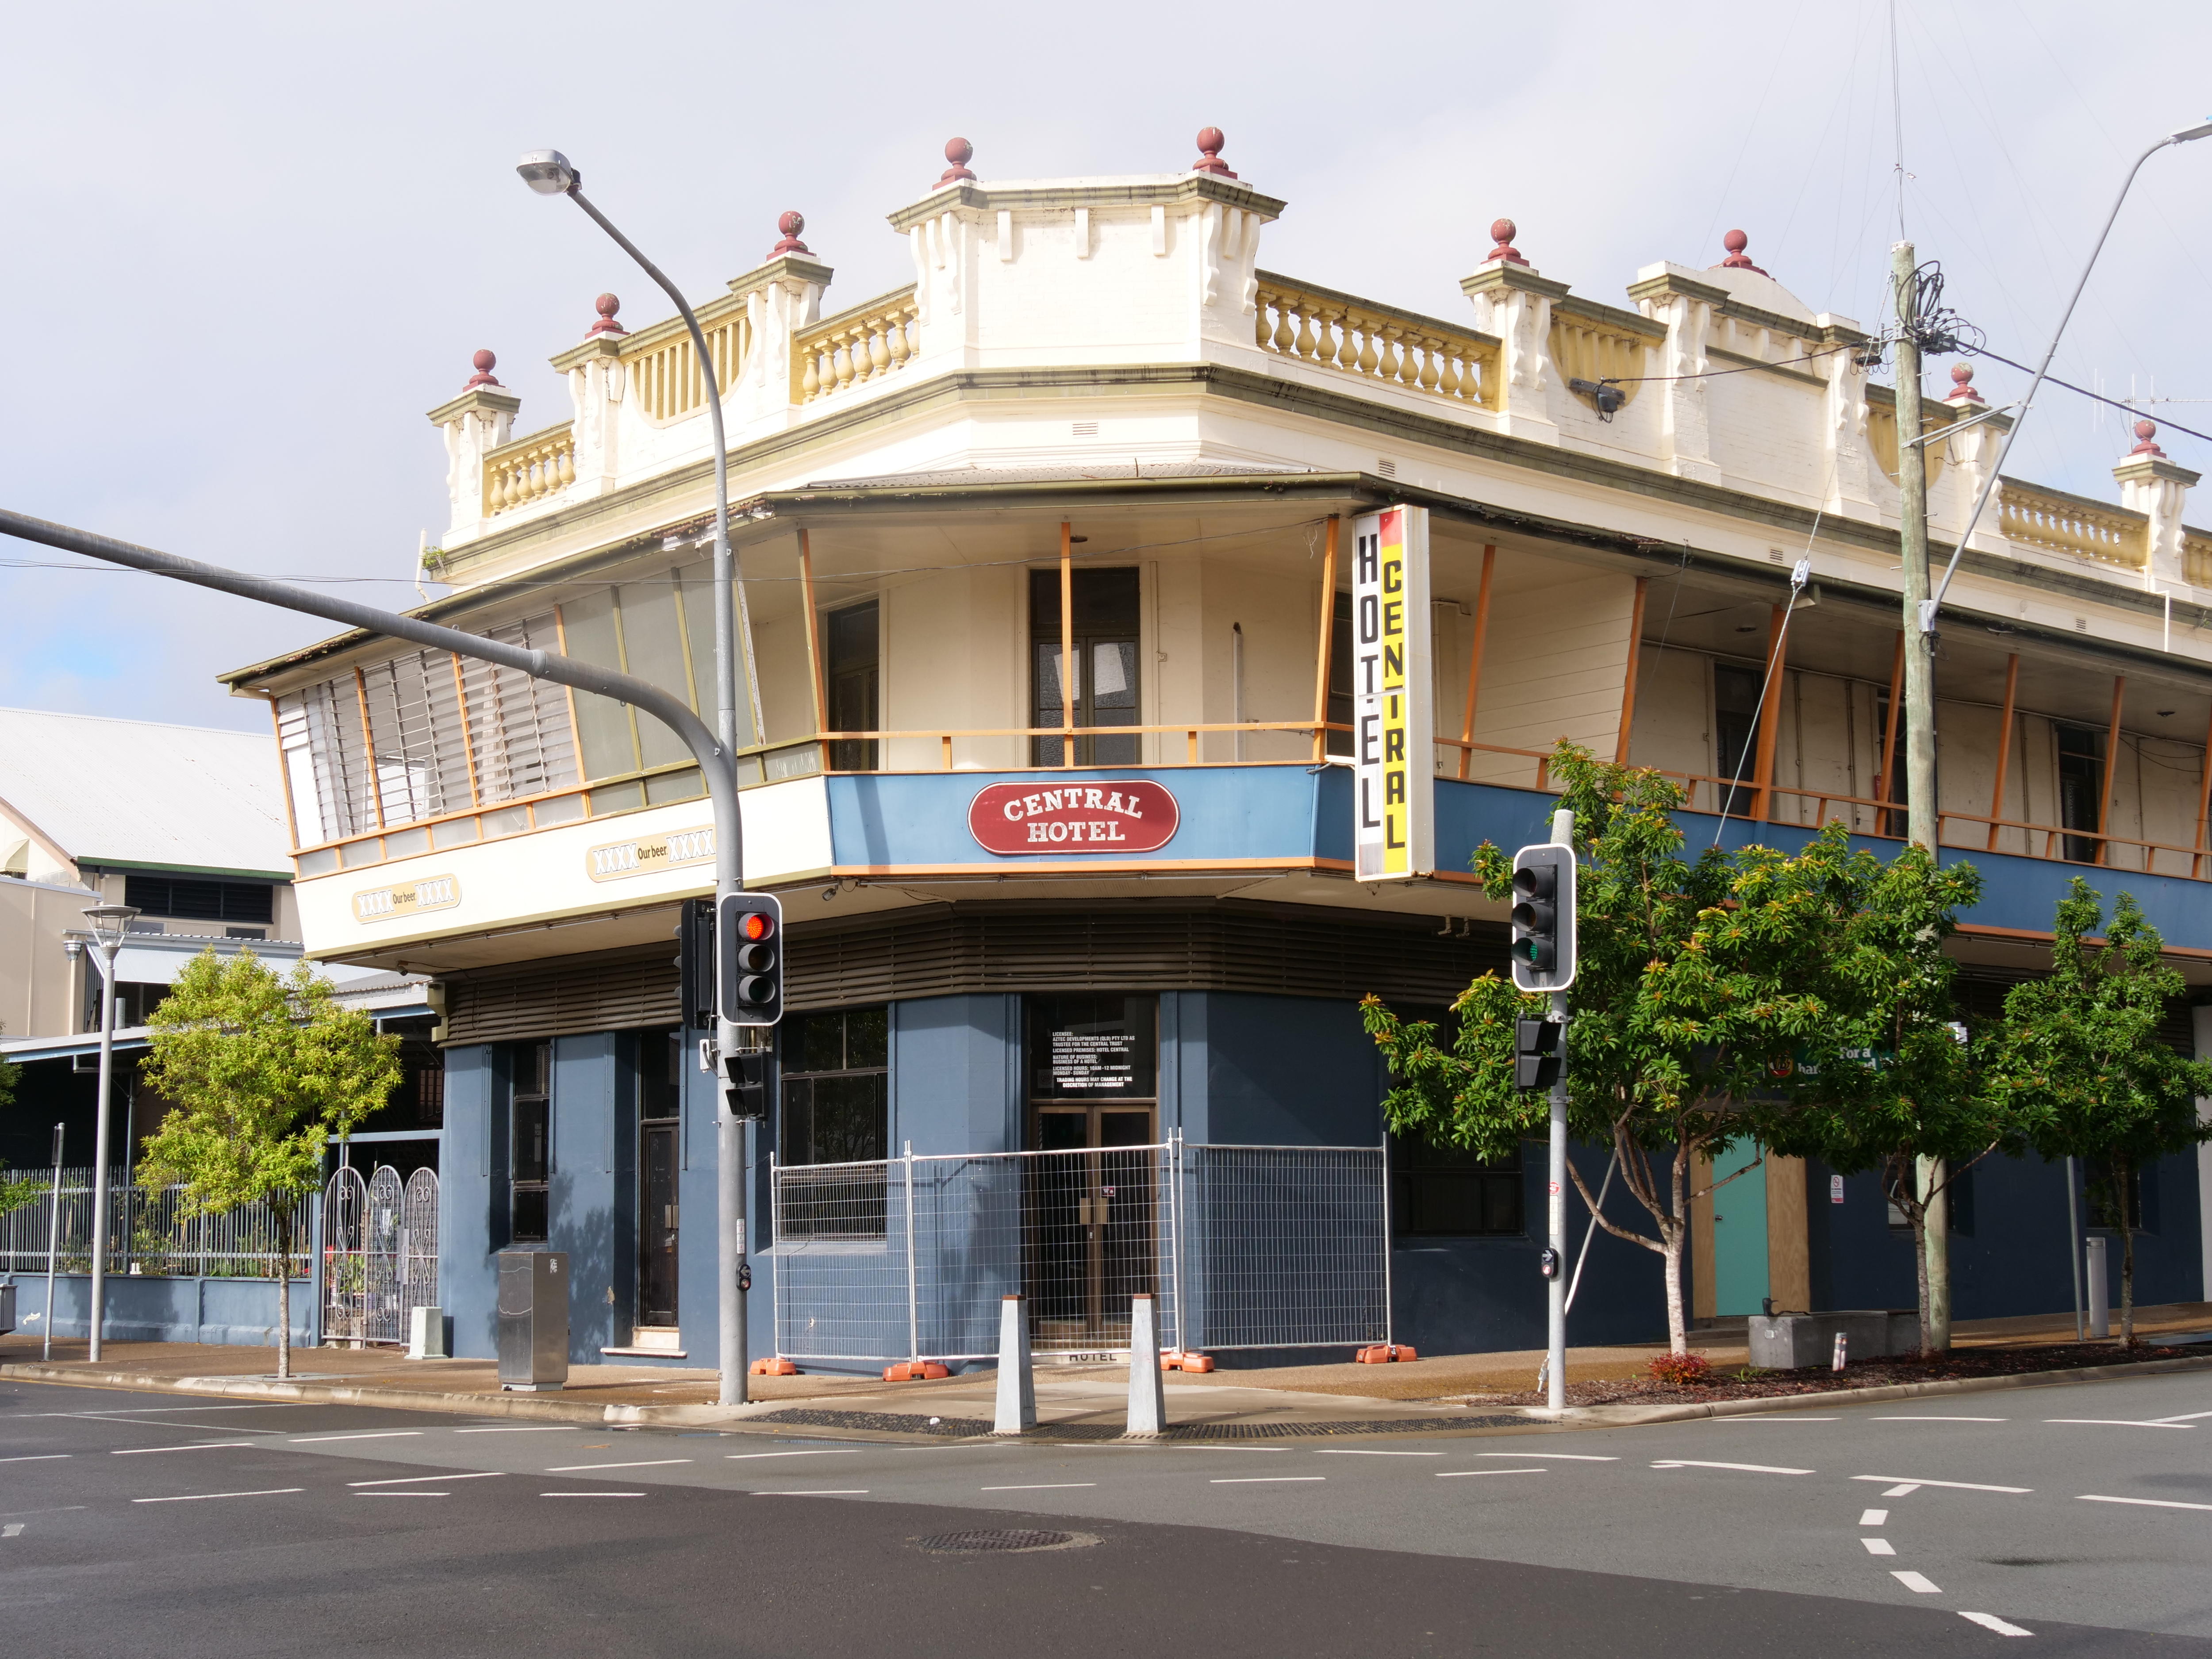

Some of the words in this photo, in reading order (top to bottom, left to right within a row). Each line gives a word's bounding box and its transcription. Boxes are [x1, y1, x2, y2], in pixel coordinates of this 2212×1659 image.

[1358, 533, 1381, 829] HOTEL
[1383, 560, 1406, 849] CENTRAL
[1004, 788, 1143, 822] CENTRAL
[1027, 821, 1125, 842] HOTEL
[593, 843, 639, 875] XXXX
[637, 847, 650, 860] Our
[666, 829, 716, 862] XXXX
[357, 890, 395, 917] XXXX
[393, 893, 403, 905] Our
[415, 878, 454, 906] XXXX
[1839, 1047, 1860, 1059] For
[1862, 1047, 1871, 1058] a
